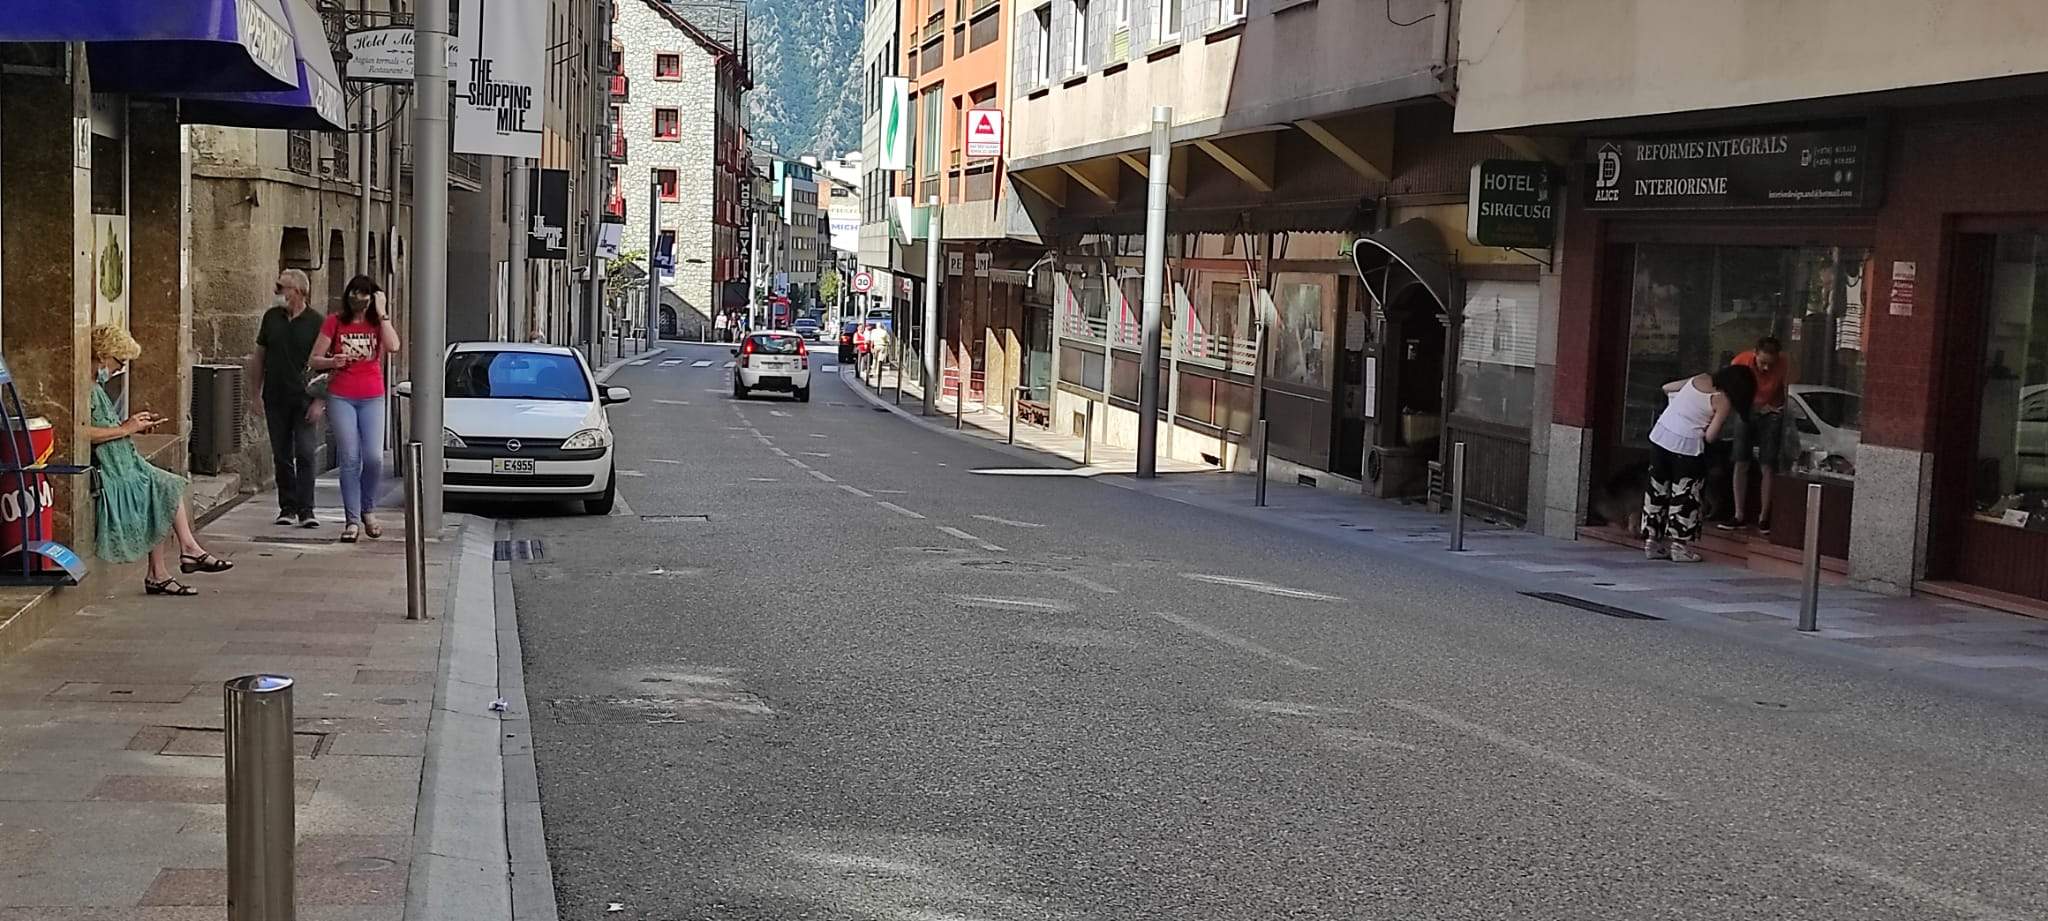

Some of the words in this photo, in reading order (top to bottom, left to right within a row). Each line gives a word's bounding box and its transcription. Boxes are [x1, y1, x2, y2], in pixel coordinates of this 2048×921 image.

[353, 33, 388, 49] Hotel
[469, 58, 493, 82] THE
[468, 82, 531, 109] SHOPPING
[497, 107, 526, 132] MILE
[1636, 142, 1704, 161] REFORMES
[1707, 136, 1788, 158] INTEGRALS
[1484, 173, 1534, 192] HOTEL
[1634, 177, 1728, 196] INTERIORISME
[1595, 189, 1619, 201] ALICE
[857, 278, 869, 286] 30
[504, 460, 533, 471] E4955
